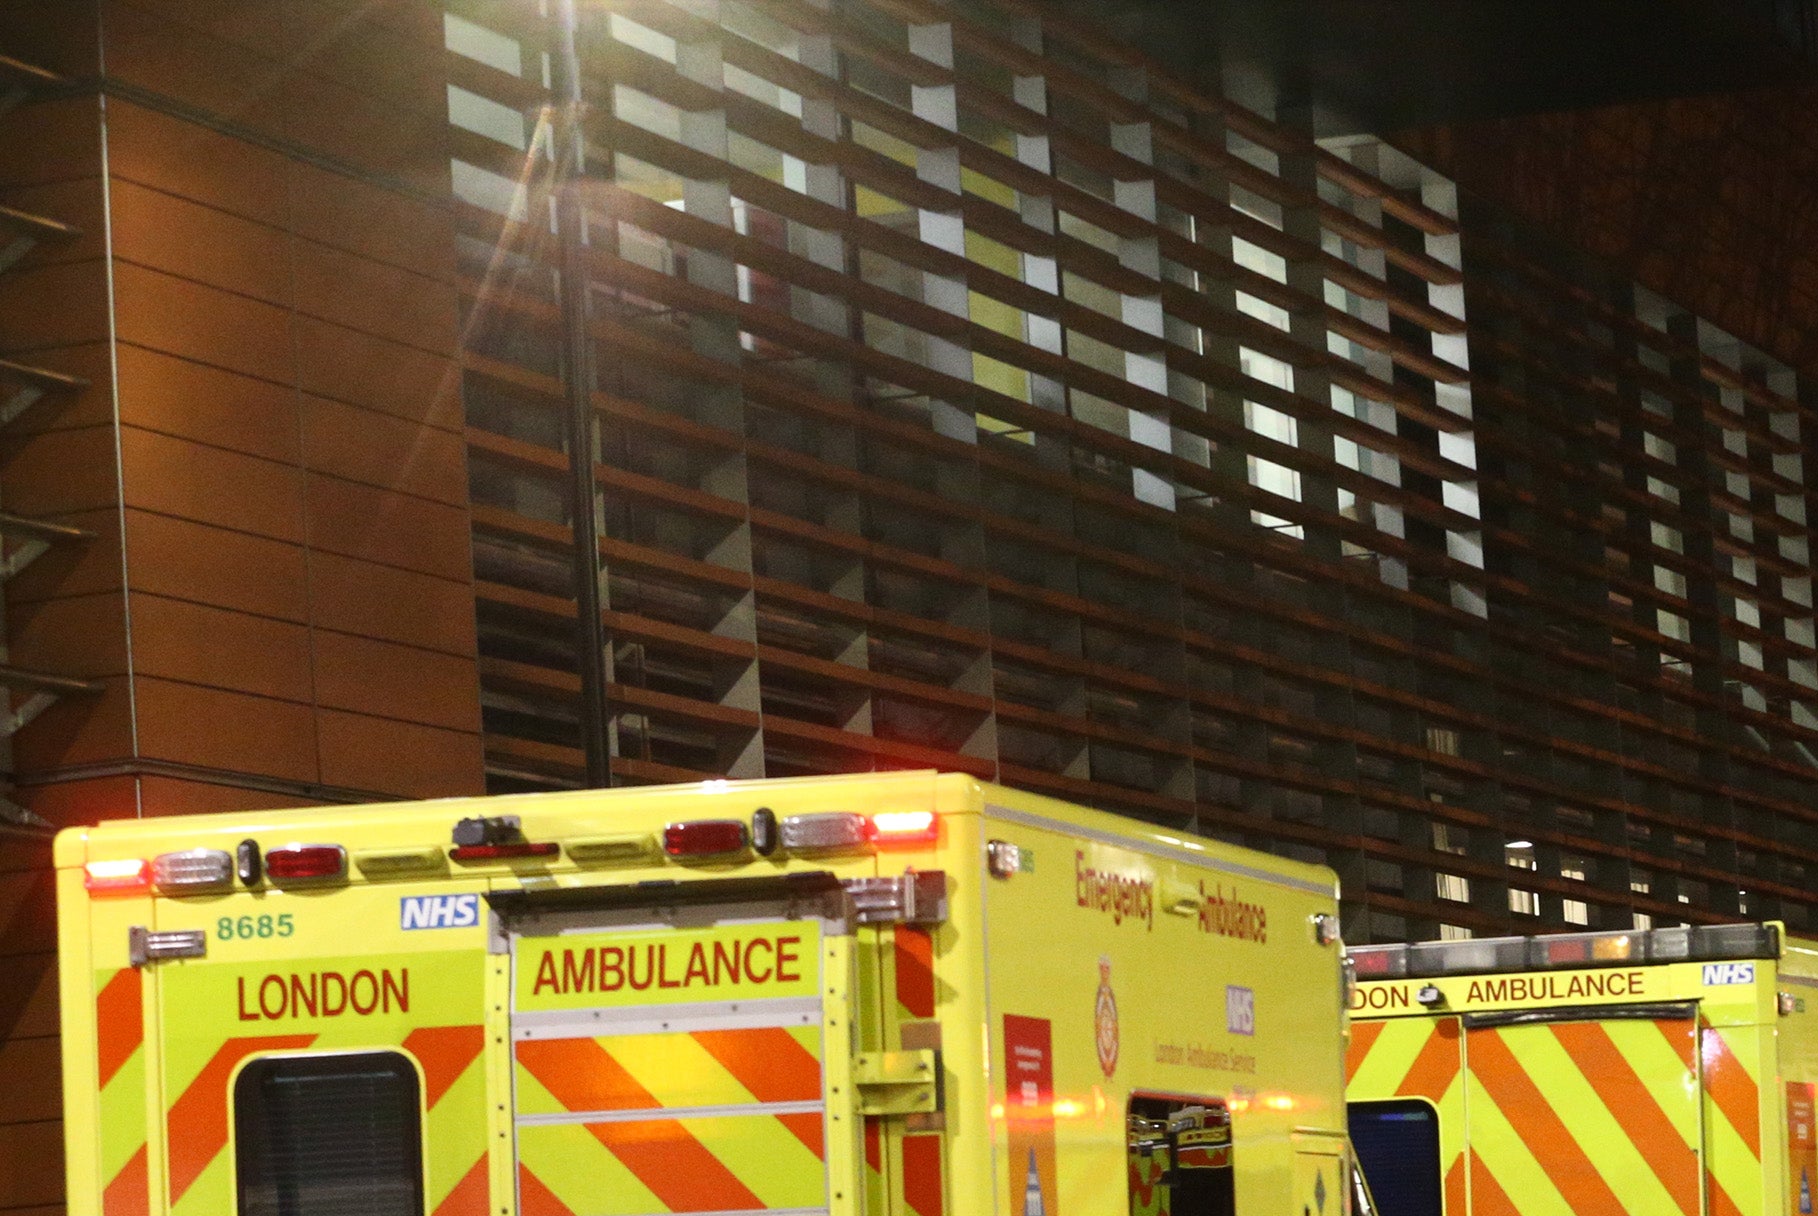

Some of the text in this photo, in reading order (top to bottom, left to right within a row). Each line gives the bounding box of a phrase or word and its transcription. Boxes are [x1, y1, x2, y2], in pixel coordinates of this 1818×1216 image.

[402, 895, 477, 929] NHS
[1076, 850, 1267, 944] Emergency Ambulance
[217, 914, 294, 941] 8685
[533, 936, 801, 995] AMBULANCE
[1702, 963, 1754, 985] NHS
[238, 968, 409, 1021] LONDON
[1466, 972, 1645, 1003] AMBULANCE
